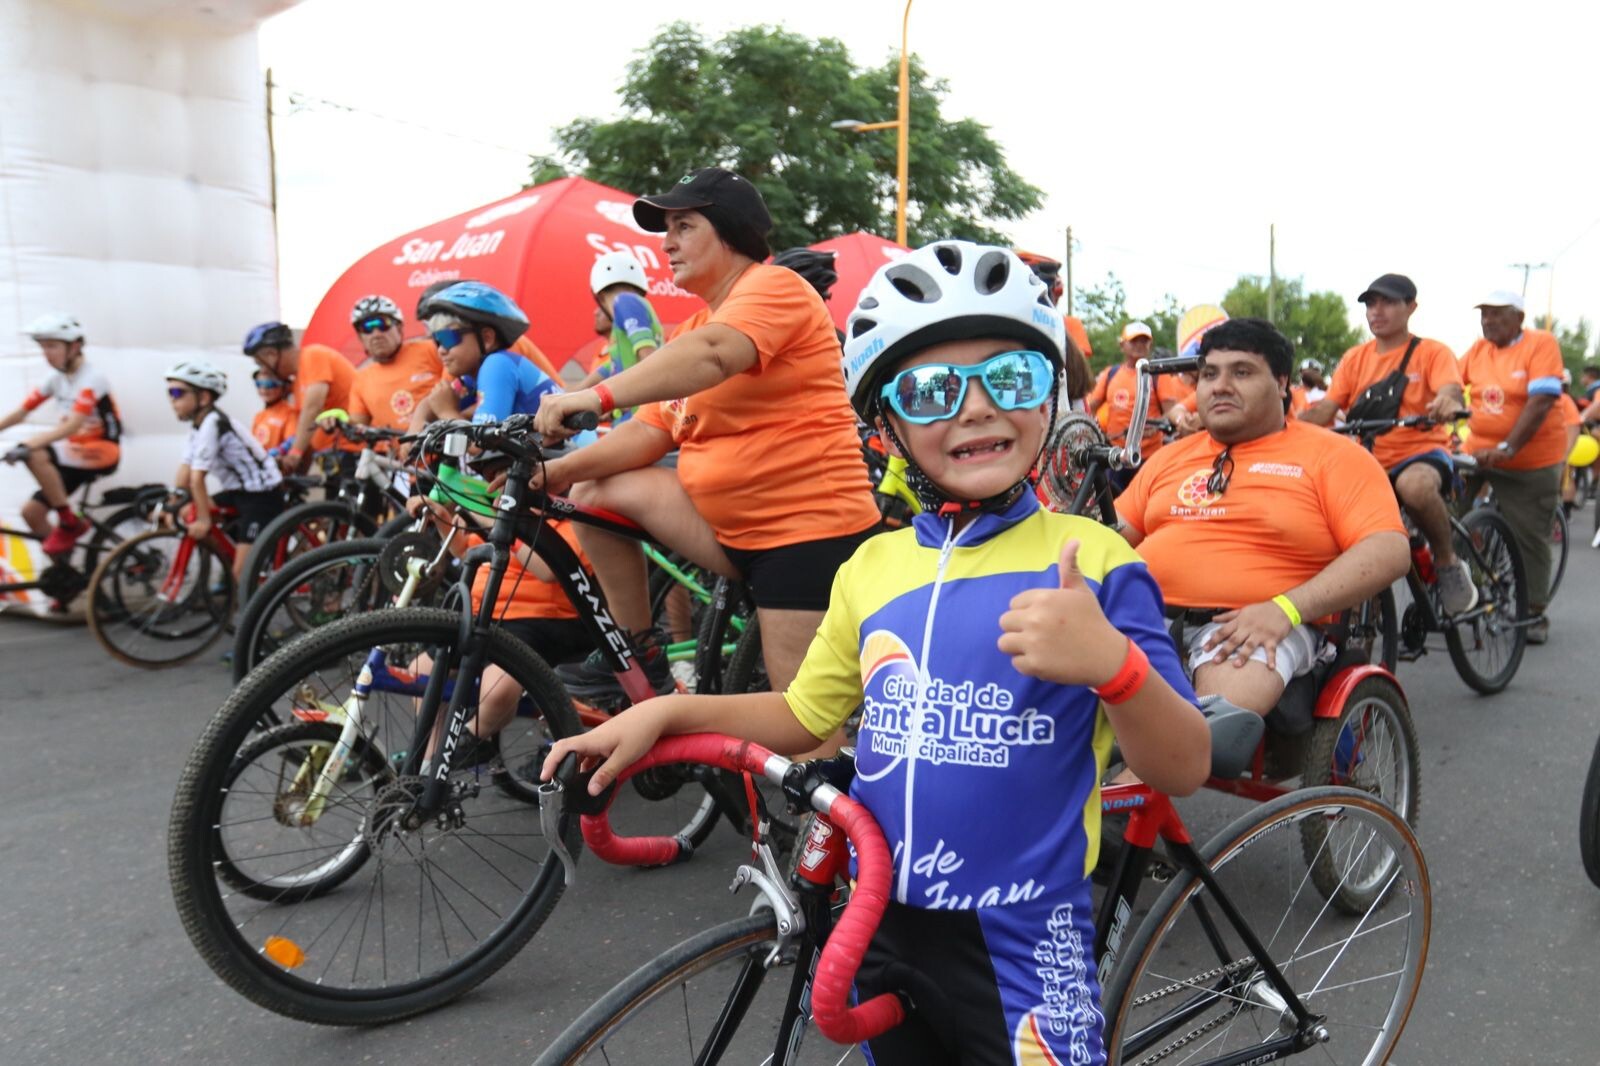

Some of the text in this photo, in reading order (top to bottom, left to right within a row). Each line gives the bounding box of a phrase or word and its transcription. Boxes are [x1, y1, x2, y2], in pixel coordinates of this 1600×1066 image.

[392, 230, 505, 265] San Juan
[569, 566, 633, 670] RAZEL
[976, 683, 1014, 711] de
[435, 708, 466, 781] RAZEL
[949, 708, 1055, 745] Lucía
[871, 732, 1009, 768] Municipalidad
[912, 839, 965, 879] de
